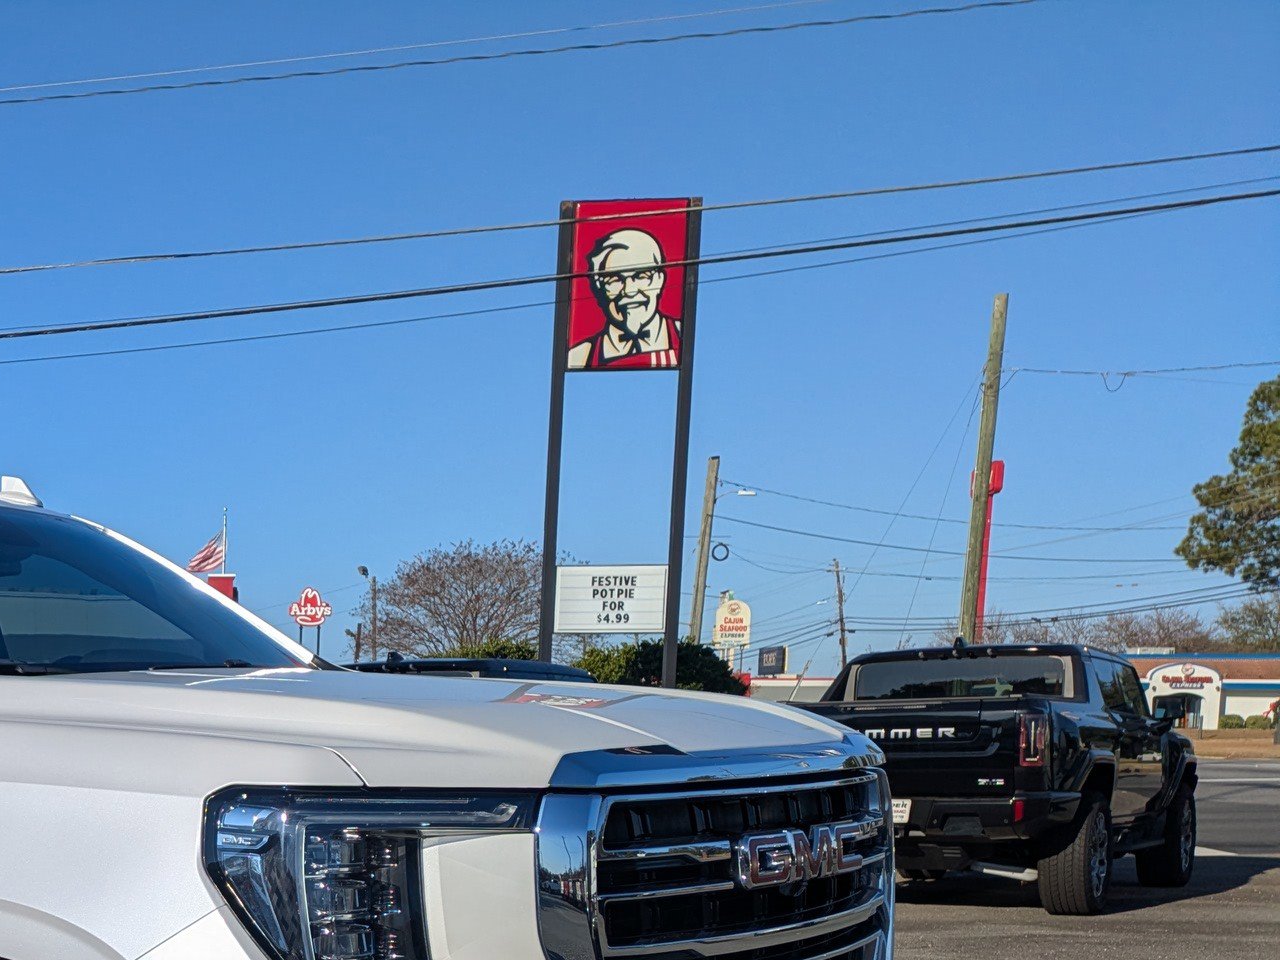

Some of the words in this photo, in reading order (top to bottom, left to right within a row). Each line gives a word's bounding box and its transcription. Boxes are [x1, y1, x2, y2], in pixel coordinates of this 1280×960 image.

[591, 576, 637, 587] FESTIVE
[592, 588, 615, 599] POT
[617, 588, 635, 599] PIE
[290, 603, 332, 618] Arby's
[602, 601, 625, 611] FOR
[597, 613, 630, 624] $4.99
[724, 616, 744, 624] CAJUN
[857, 727, 956, 739] MMER
[739, 826, 863, 889] GMC
